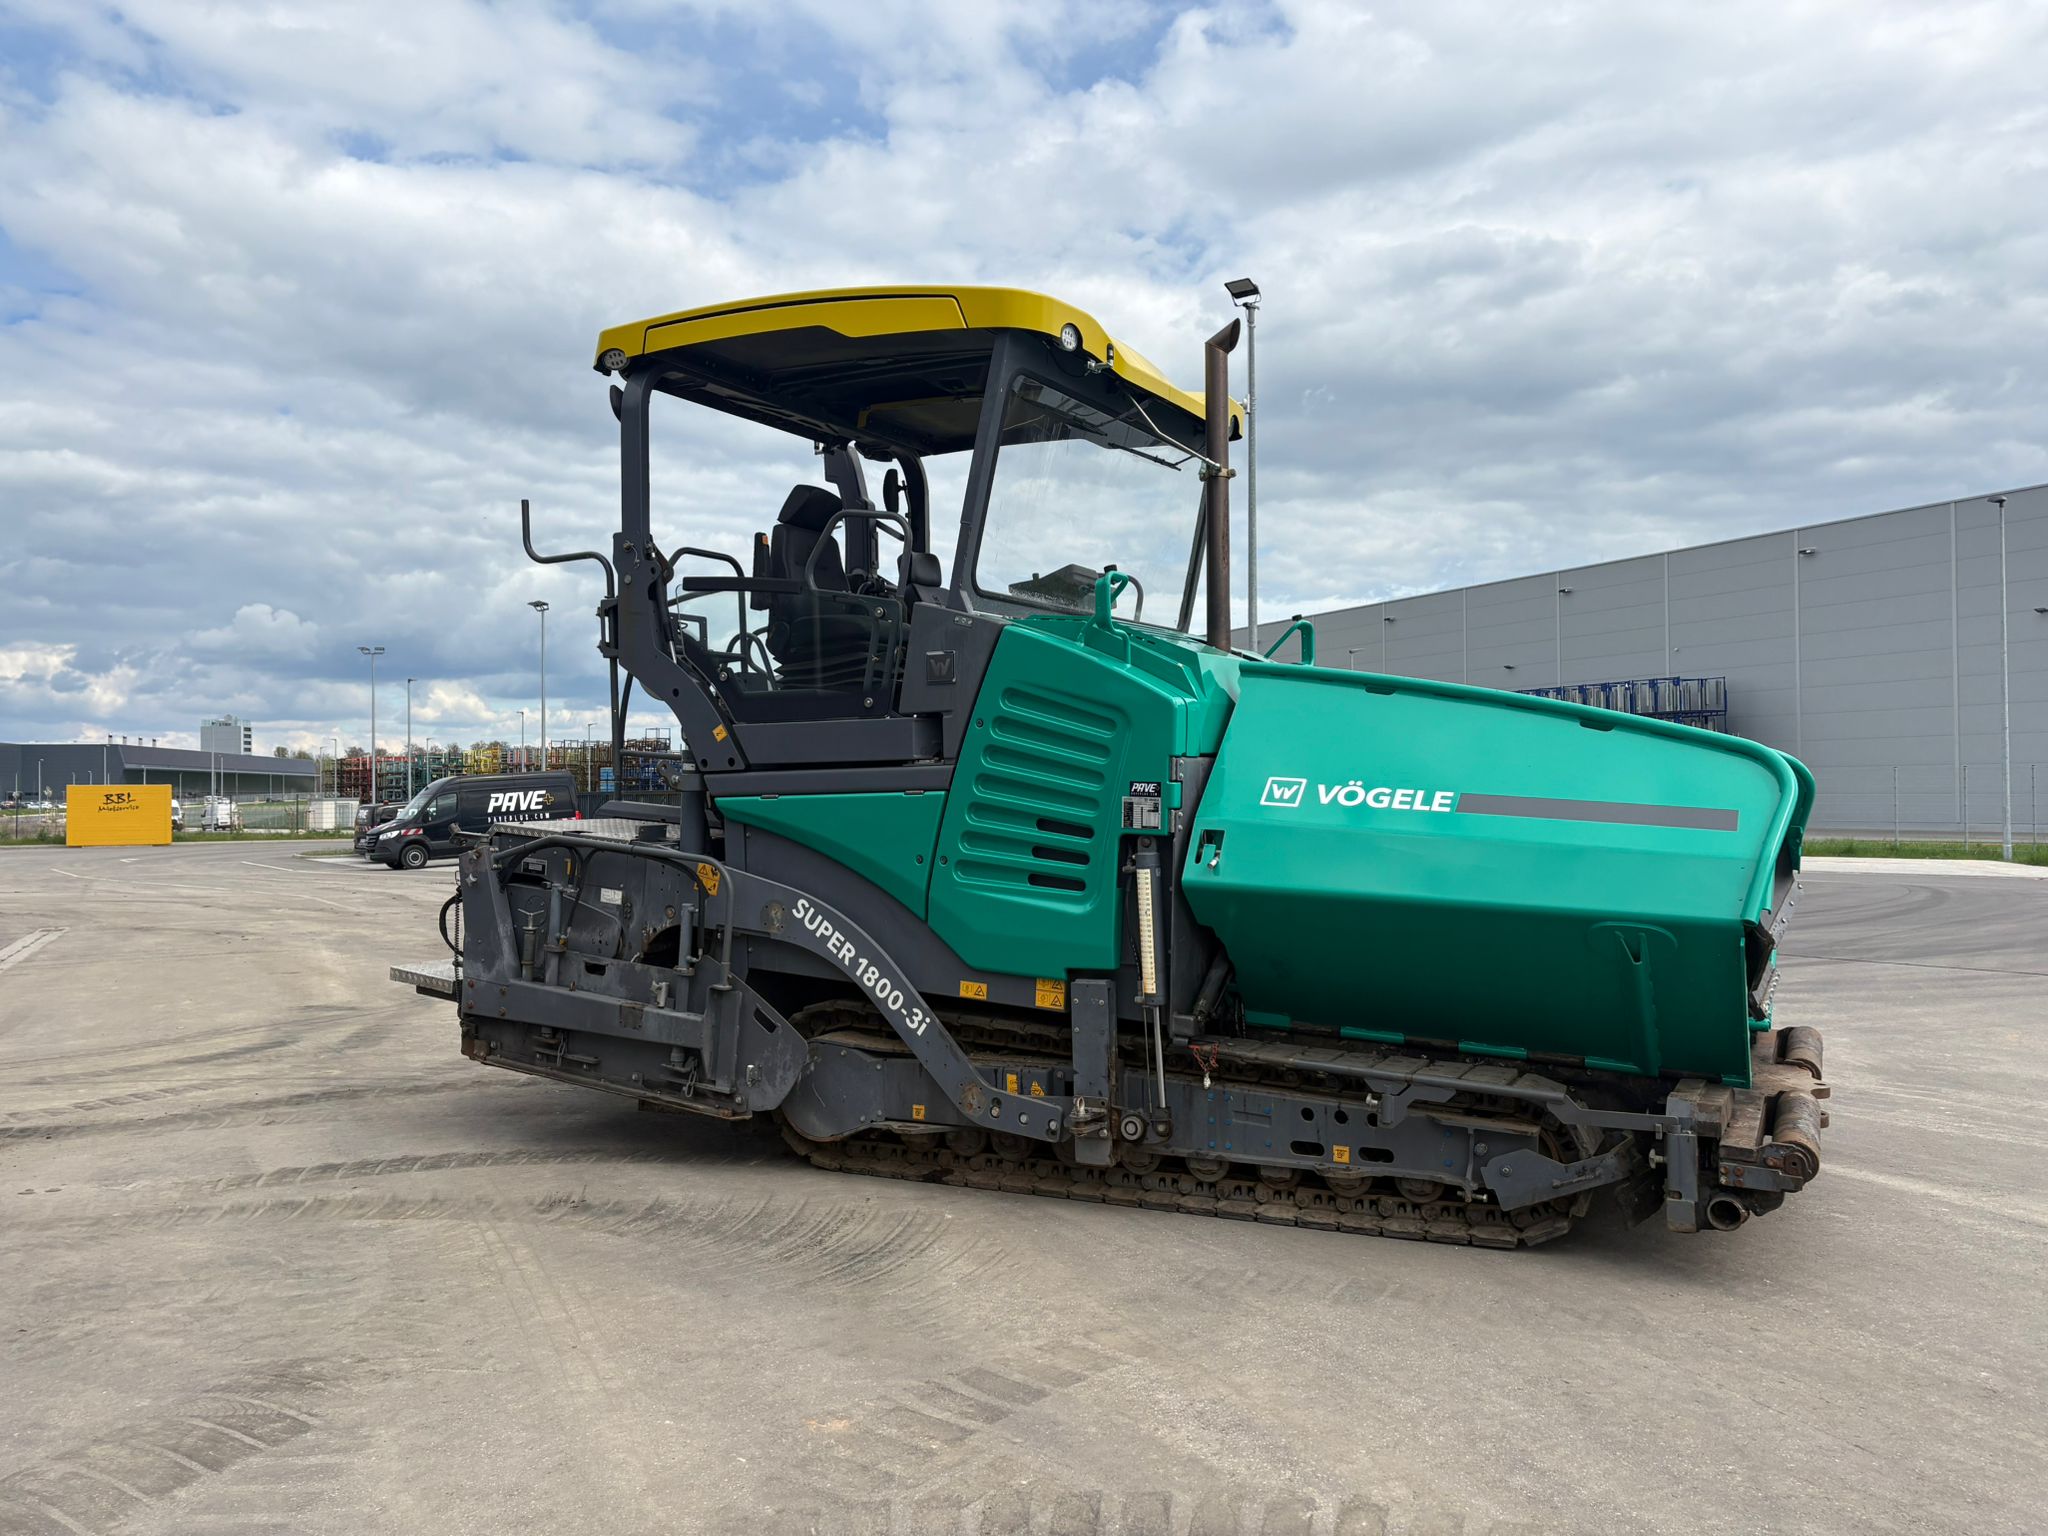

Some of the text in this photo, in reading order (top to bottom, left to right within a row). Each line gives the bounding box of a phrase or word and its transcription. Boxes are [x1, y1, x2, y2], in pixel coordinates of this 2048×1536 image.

[102, 791, 136, 805] BBL
[1317, 780, 1454, 812] VÖGELE
[792, 898, 931, 1036] SUPER 1800-3i
